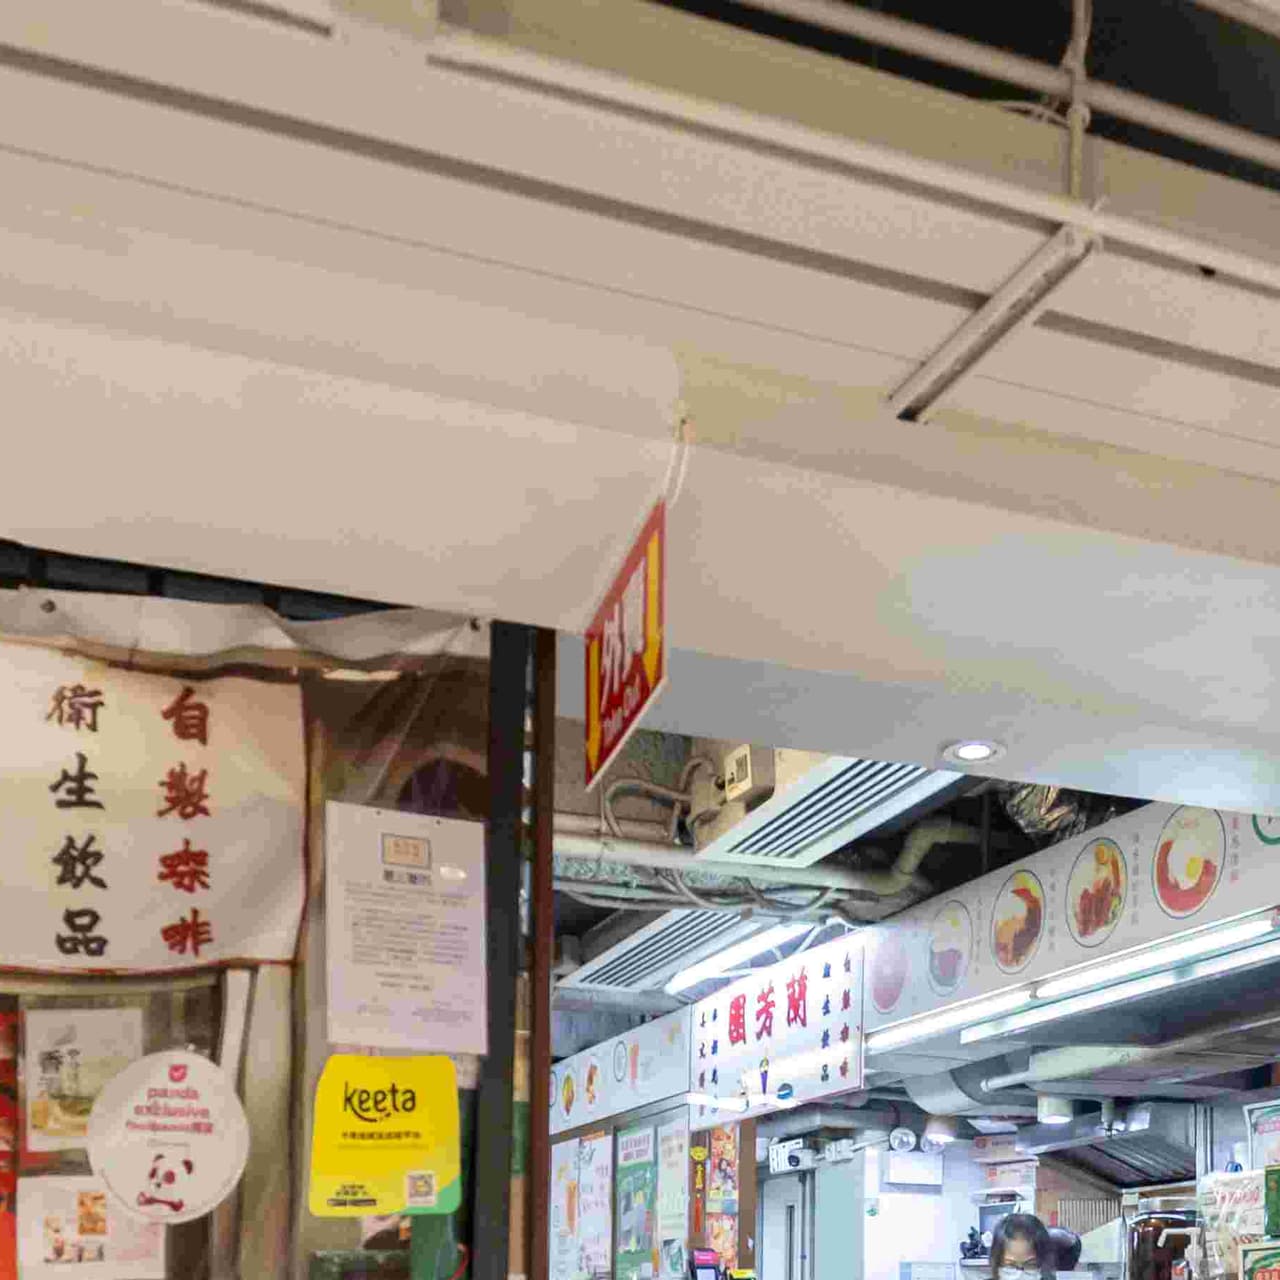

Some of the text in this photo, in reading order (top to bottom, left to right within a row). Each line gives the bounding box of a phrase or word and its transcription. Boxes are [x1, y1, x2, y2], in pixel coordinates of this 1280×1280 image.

[46, 684, 108, 957] 衛生飲品
[344, 1081, 417, 1123] keeta
